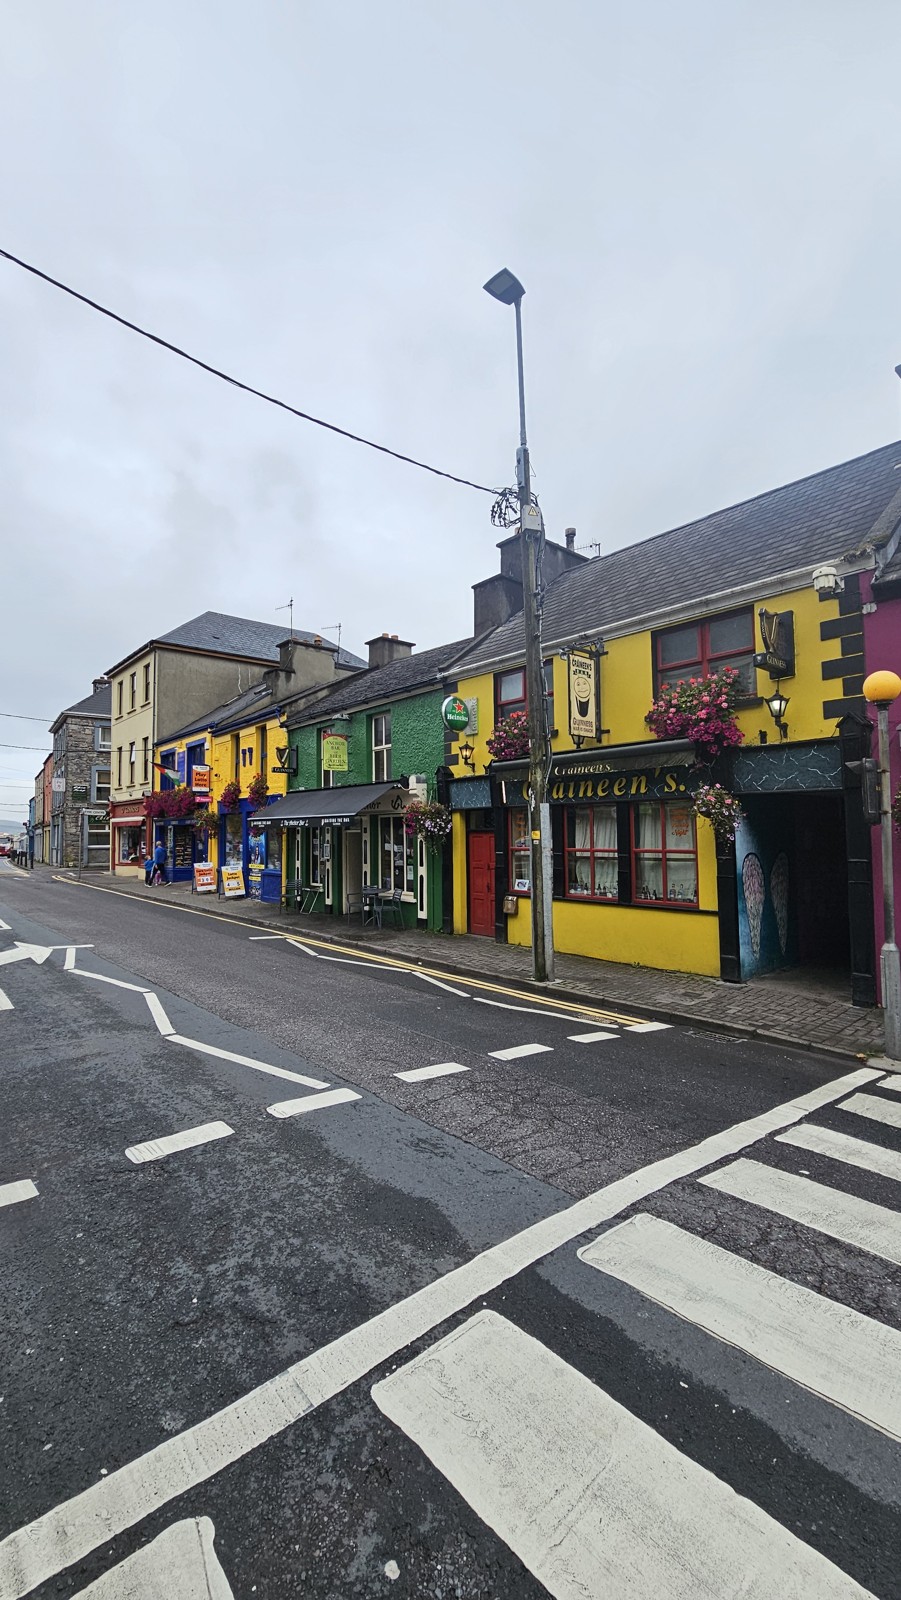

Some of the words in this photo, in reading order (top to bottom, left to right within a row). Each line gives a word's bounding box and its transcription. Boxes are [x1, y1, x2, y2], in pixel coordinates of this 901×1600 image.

[767, 654, 787, 670] GUINNESS
[447, 713, 469, 722] Heineken
[573, 717, 593, 728] GUINNESS
